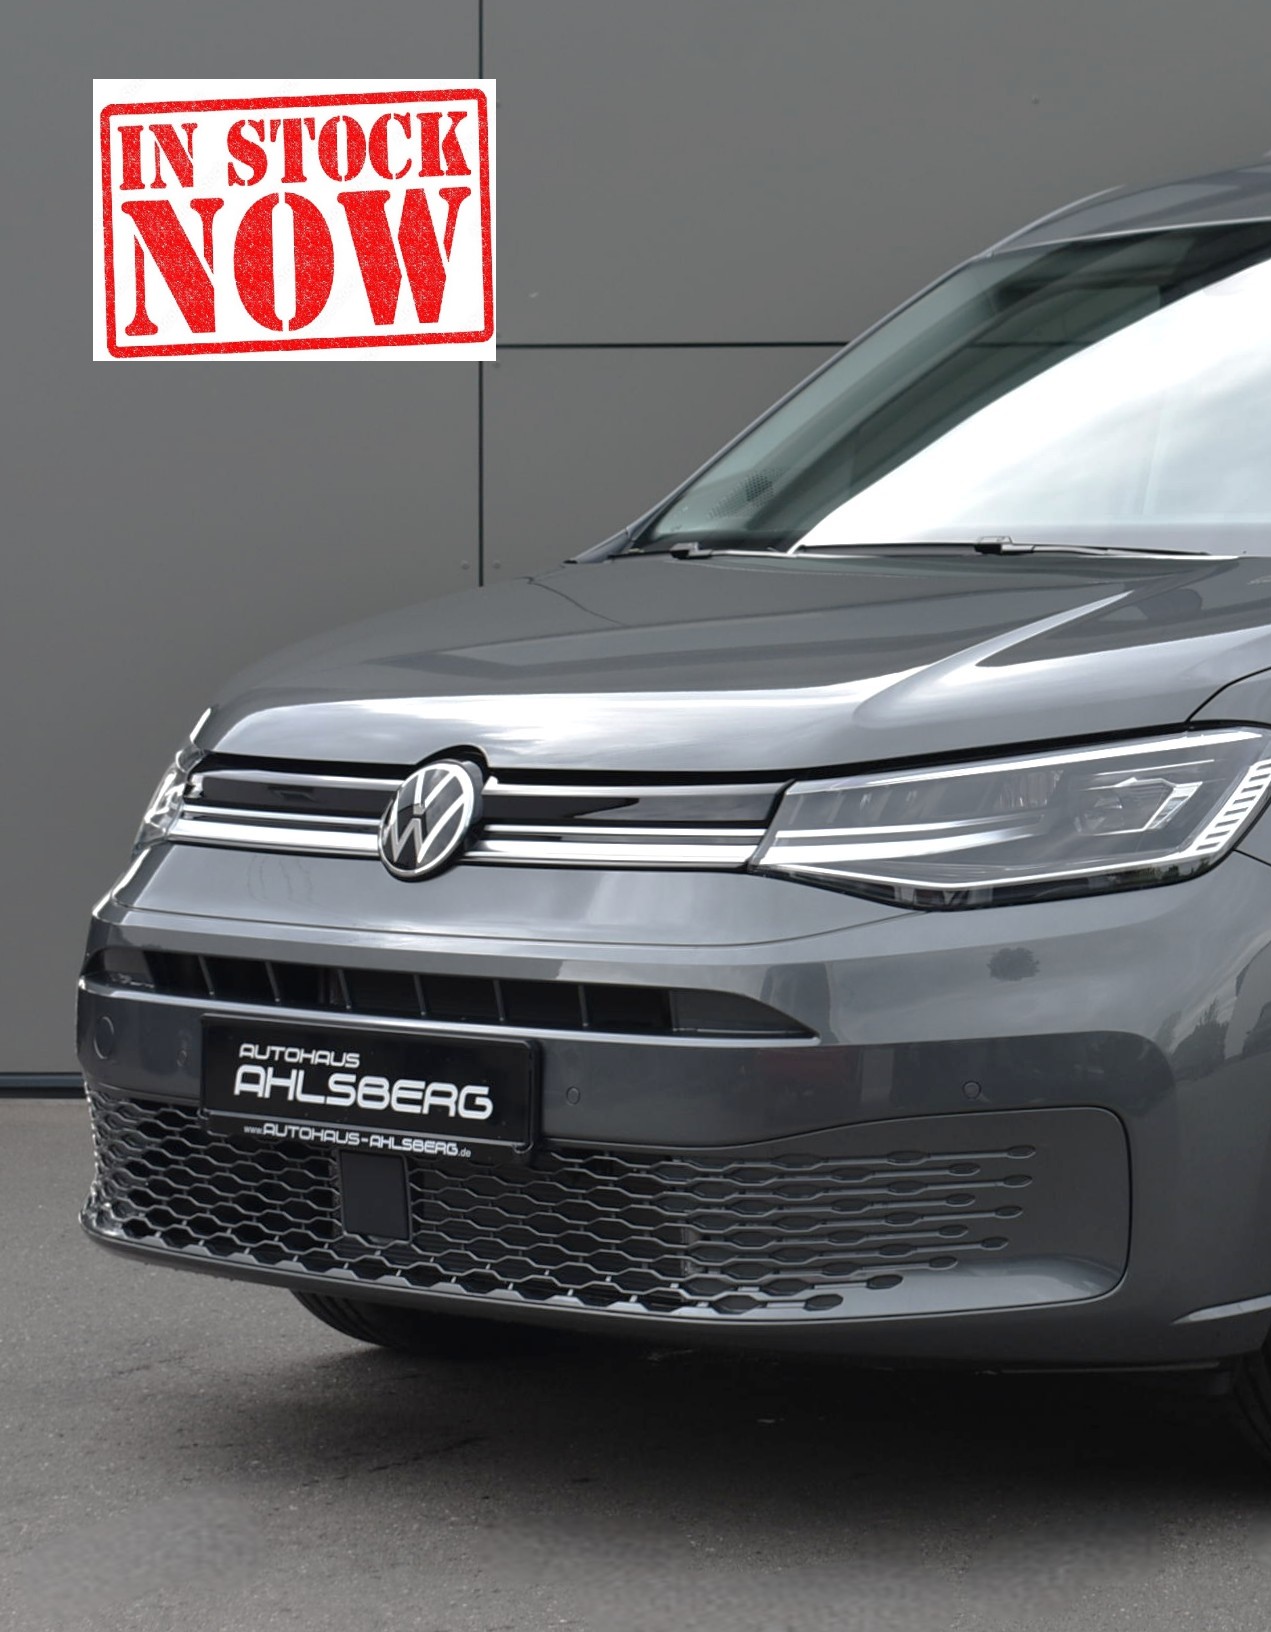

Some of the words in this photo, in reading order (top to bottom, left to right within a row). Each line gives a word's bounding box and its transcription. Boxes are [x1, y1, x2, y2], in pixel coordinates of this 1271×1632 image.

[239, 1043, 361, 1069] AUTOHAUS
[233, 1064, 494, 1120] AHLSBERG
[243, 1123, 472, 1158] www.AUTOHAUS-AHLSBERG.de
